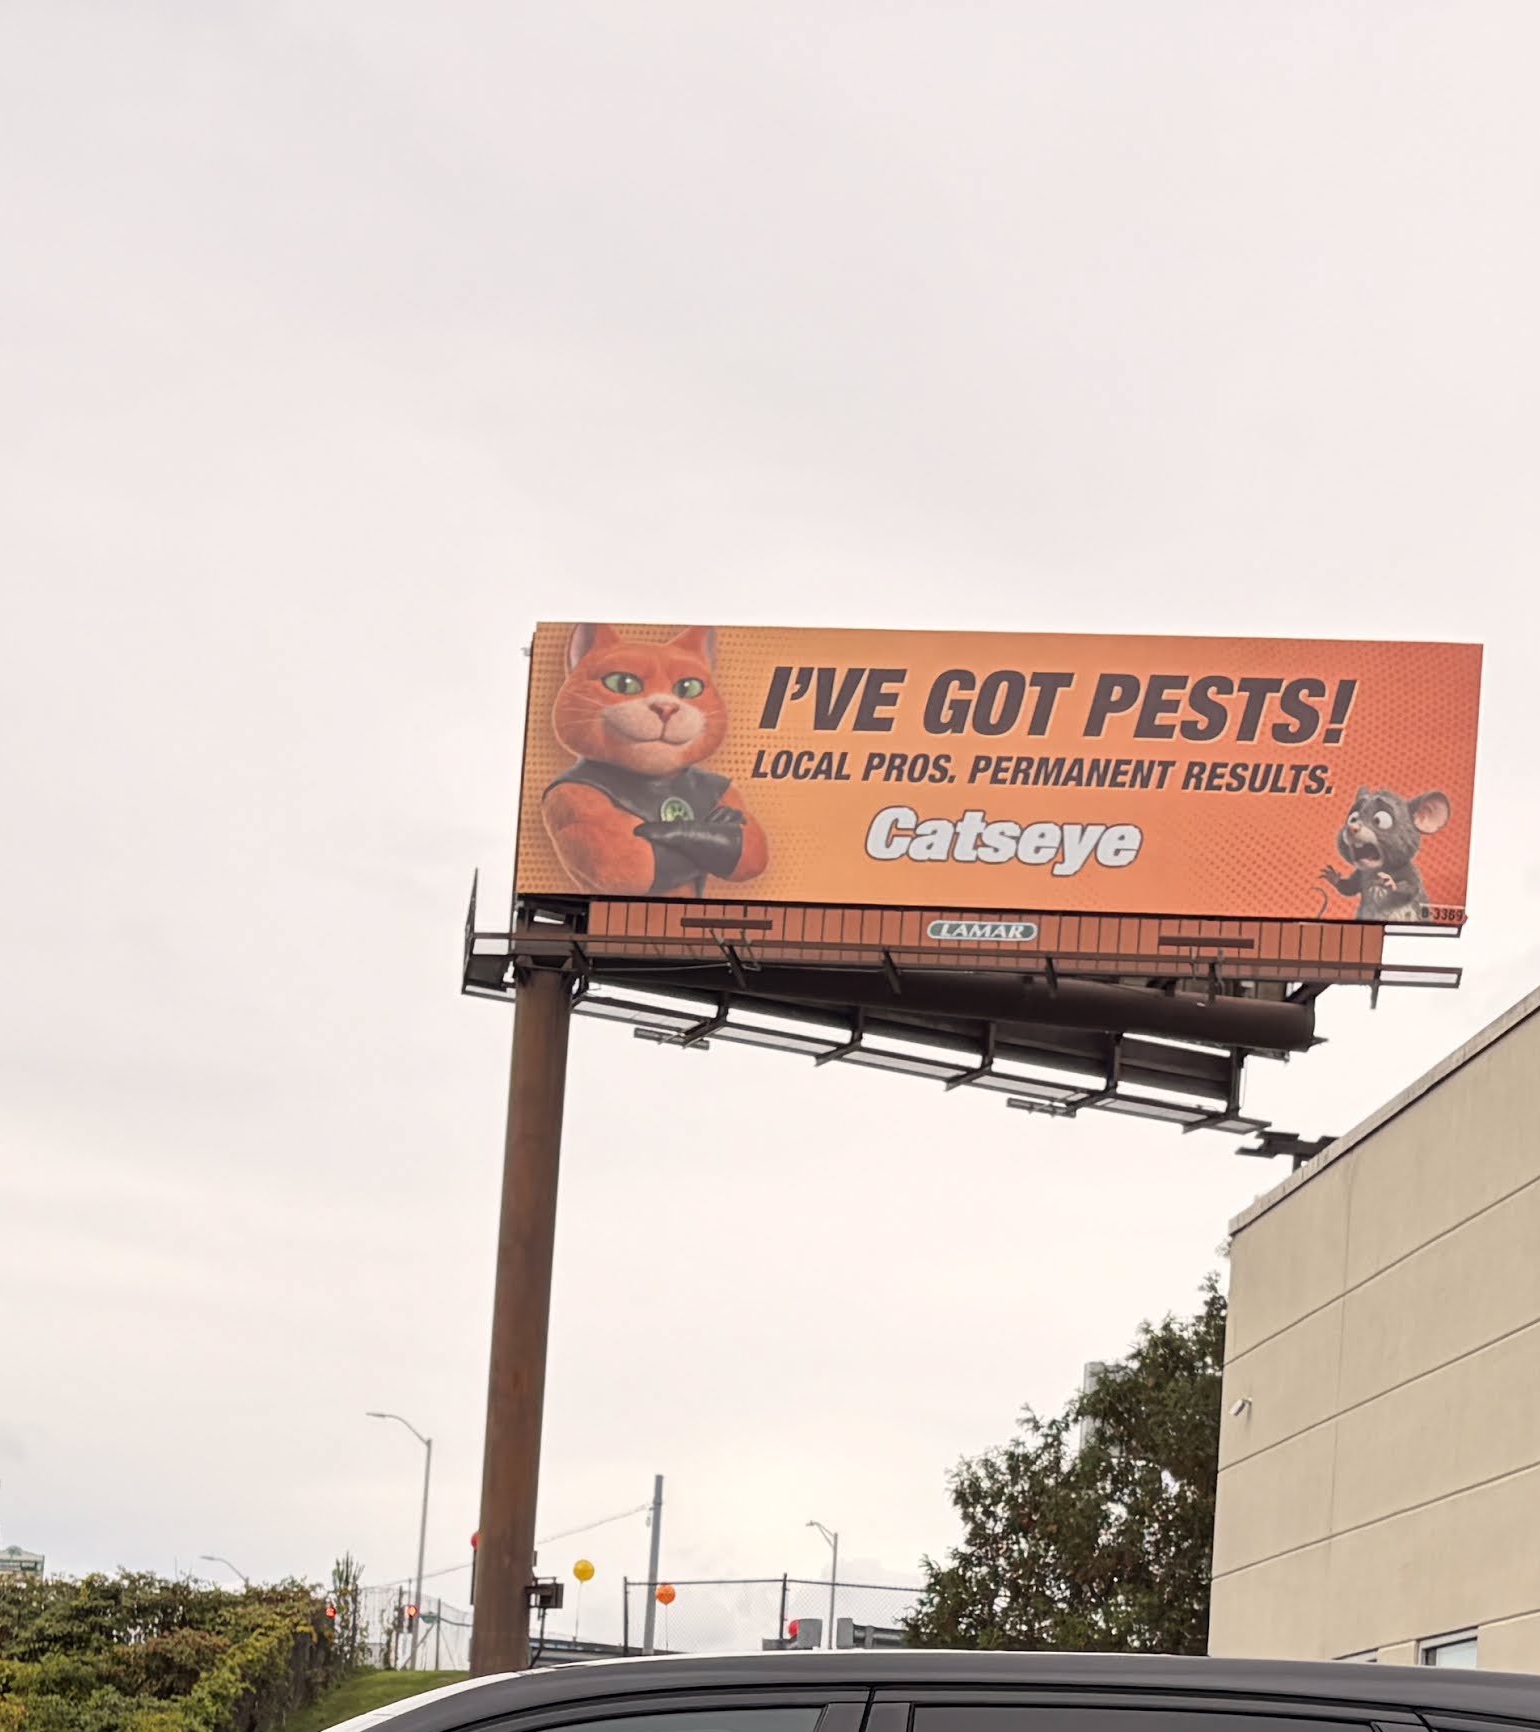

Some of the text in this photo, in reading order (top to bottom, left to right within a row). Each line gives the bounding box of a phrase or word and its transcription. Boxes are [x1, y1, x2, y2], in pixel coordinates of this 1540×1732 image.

[759, 666, 1359, 745] I'VE GOT PESTS!
[750, 749, 1335, 796] LOCAL PROS. PERMANENT RESULTS.
[865, 805, 1143, 877] Catseye
[940, 923, 1024, 938] LAMAR
